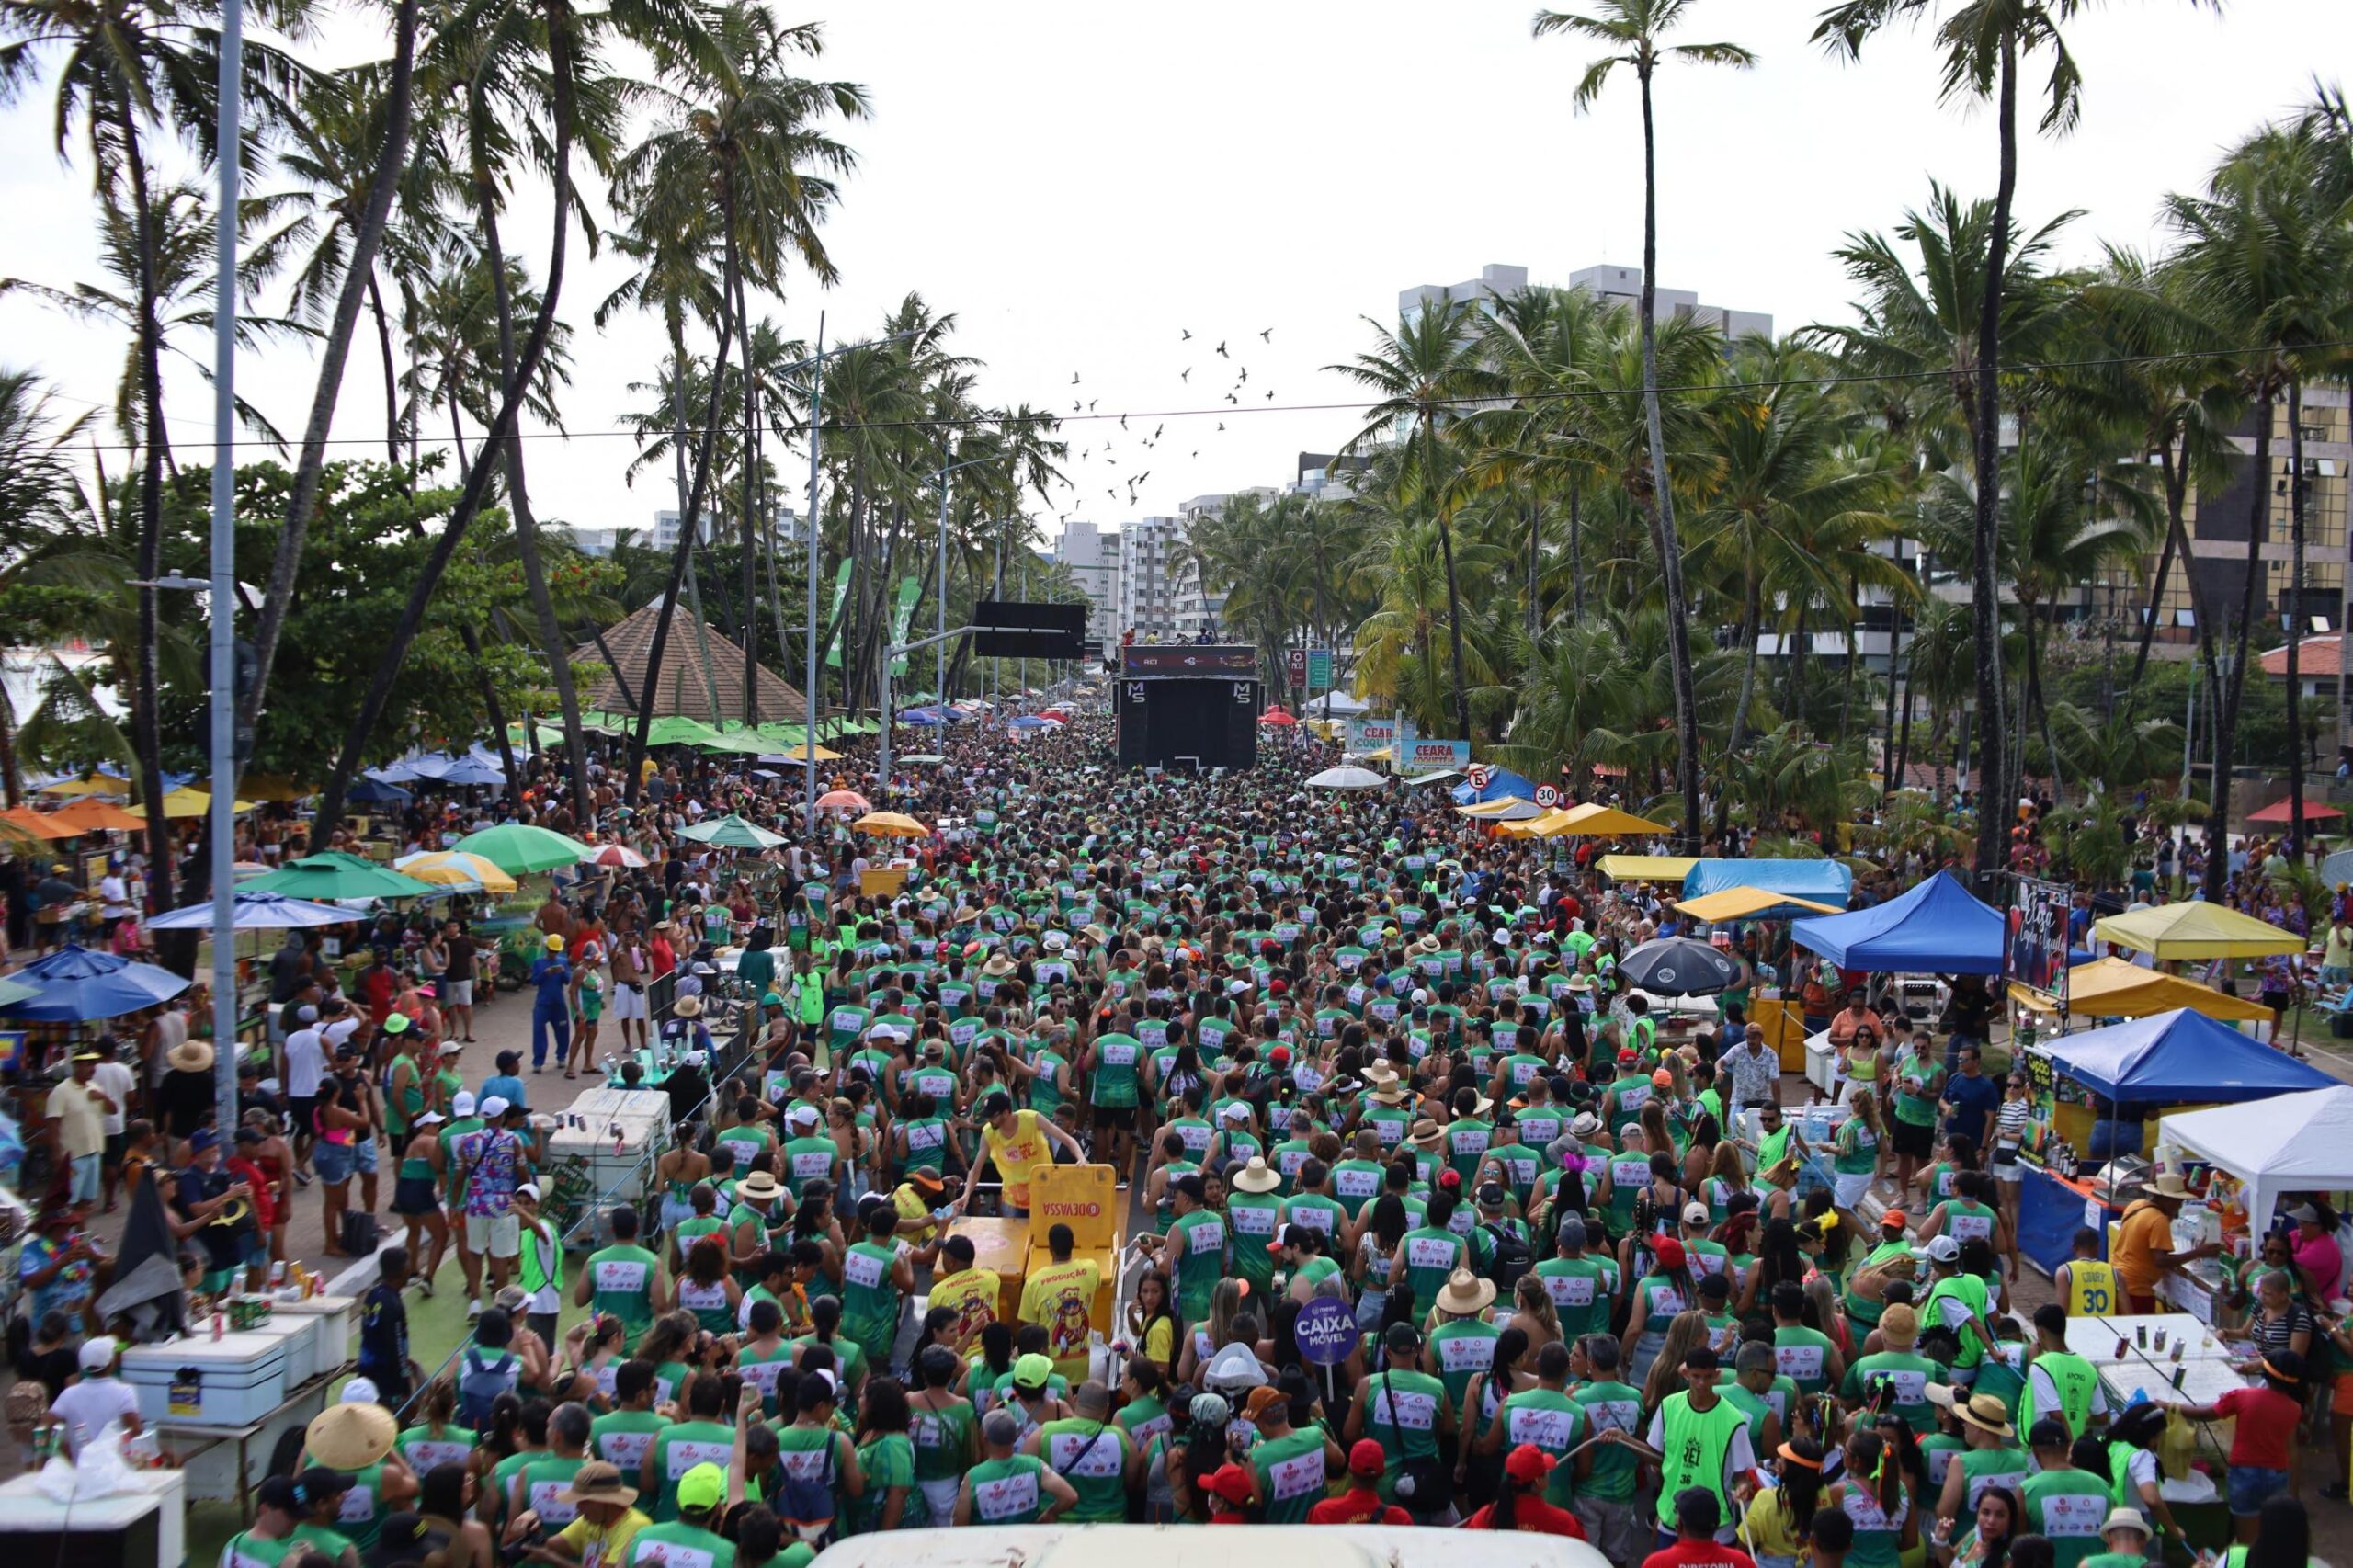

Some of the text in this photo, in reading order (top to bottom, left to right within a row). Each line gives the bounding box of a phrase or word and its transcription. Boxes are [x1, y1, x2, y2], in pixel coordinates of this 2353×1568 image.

[1415, 743, 1453, 756] CEARÁ
[1538, 789, 1555, 800] 30
[1043, 1202, 1086, 1216] DEVASSA
[1040, 1268, 1087, 1286] PRODUÇÃO
[2083, 1289, 2109, 1313] 30
[1296, 1314, 1355, 1336] CAIXA
[1679, 1474, 1692, 1485] 36
